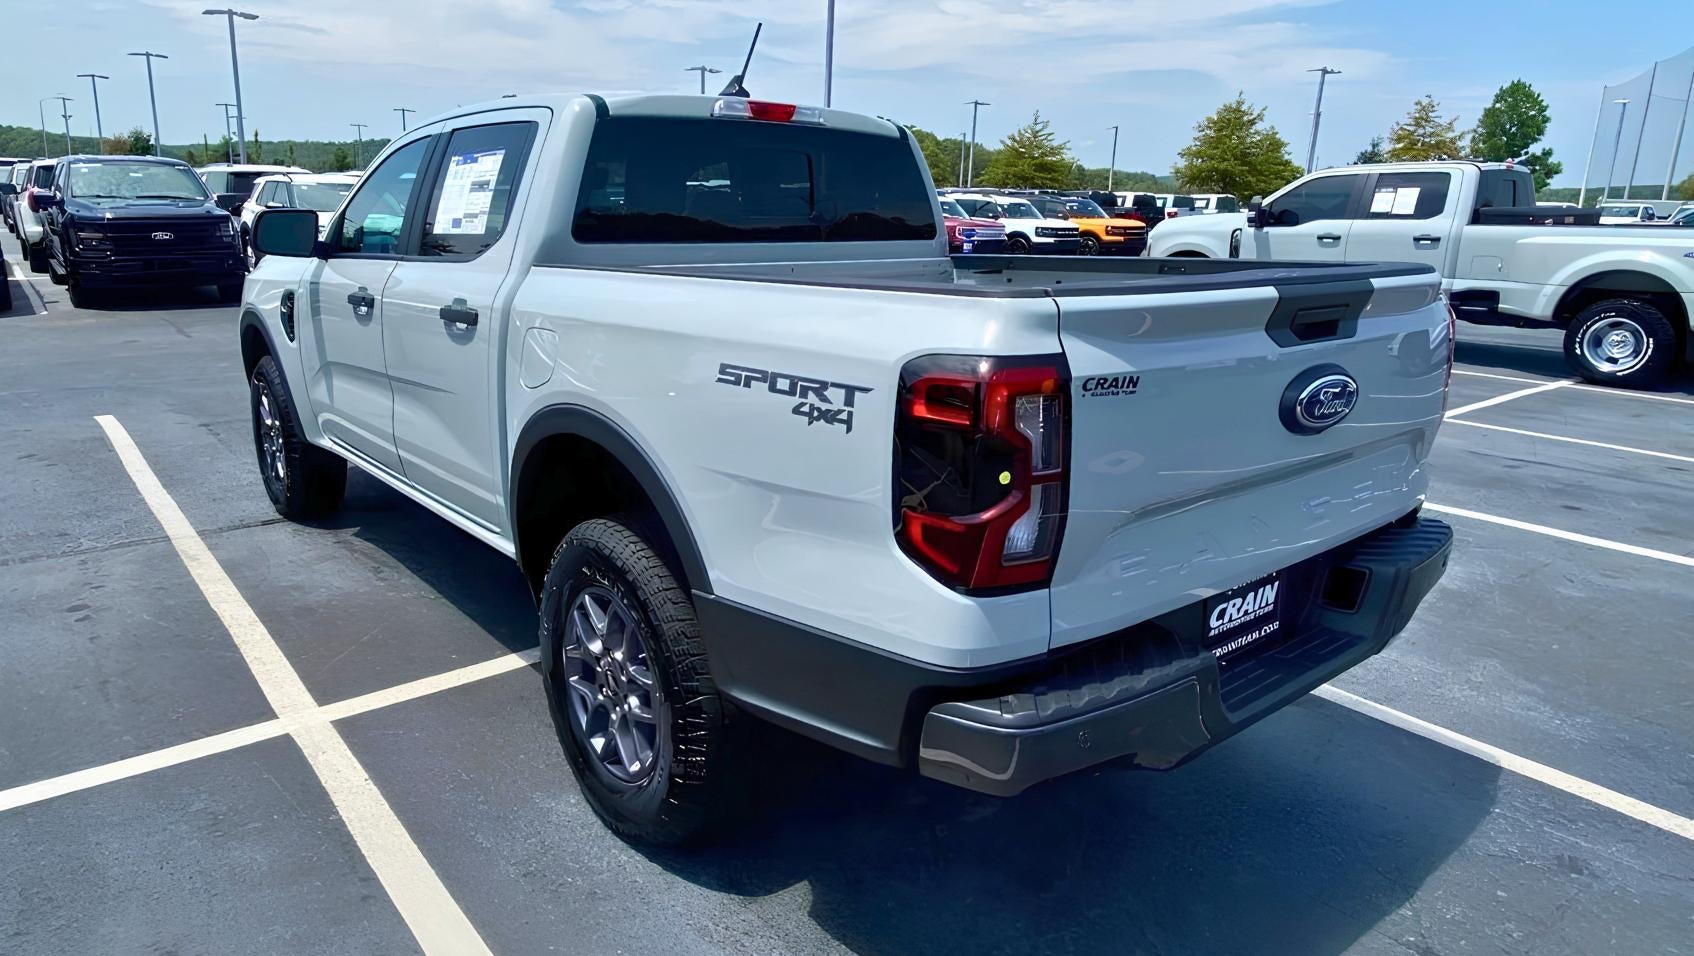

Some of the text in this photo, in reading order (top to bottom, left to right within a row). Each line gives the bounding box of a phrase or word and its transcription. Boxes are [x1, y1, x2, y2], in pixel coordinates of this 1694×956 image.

[716, 363, 875, 408] SPORT
[1082, 376, 1140, 392] CRAIN
[792, 402, 853, 435] 4x4
[1209, 581, 1279, 628] CRAIN
